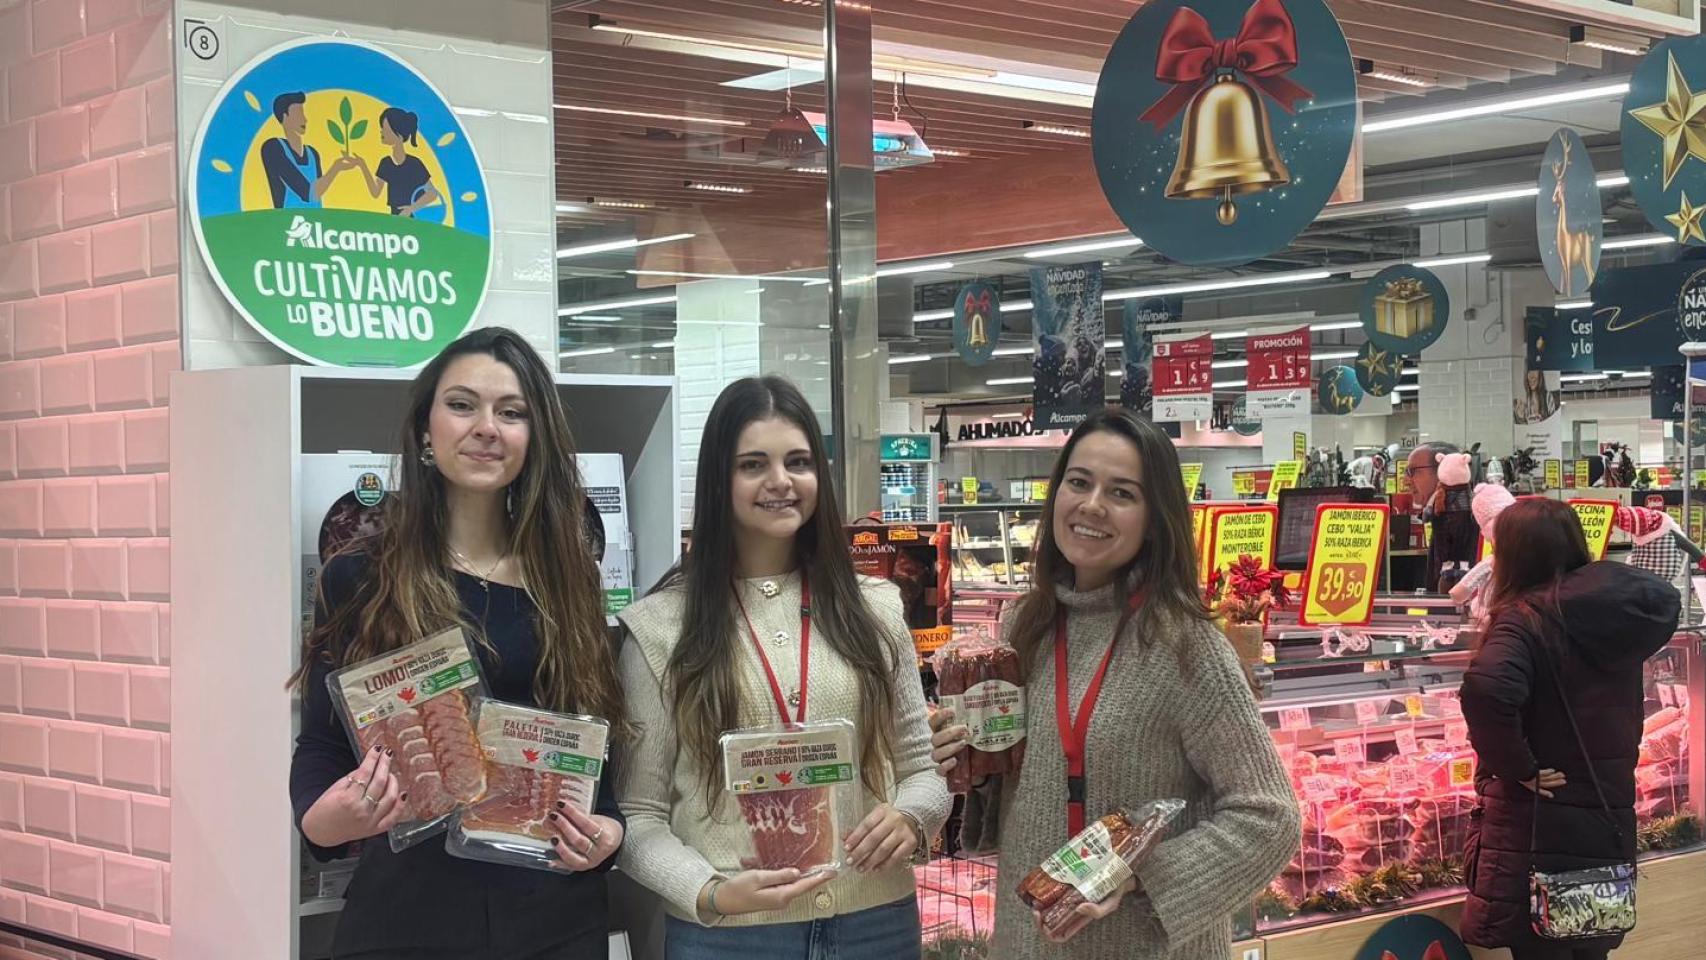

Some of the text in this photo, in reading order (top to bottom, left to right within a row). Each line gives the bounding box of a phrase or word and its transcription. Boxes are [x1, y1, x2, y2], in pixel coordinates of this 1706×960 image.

[200, 35, 209, 50] 8
[285, 215, 419, 258] Alcampo
[1046, 268, 1085, 282] NAVIDAD
[286, 301, 434, 341] LO BUENO
[1254, 336, 1303, 349] PROMOCIÓN
[1571, 338, 1594, 358] y lo
[1327, 523, 1345, 534] CEBO
[364, 665, 406, 694] LOMO
